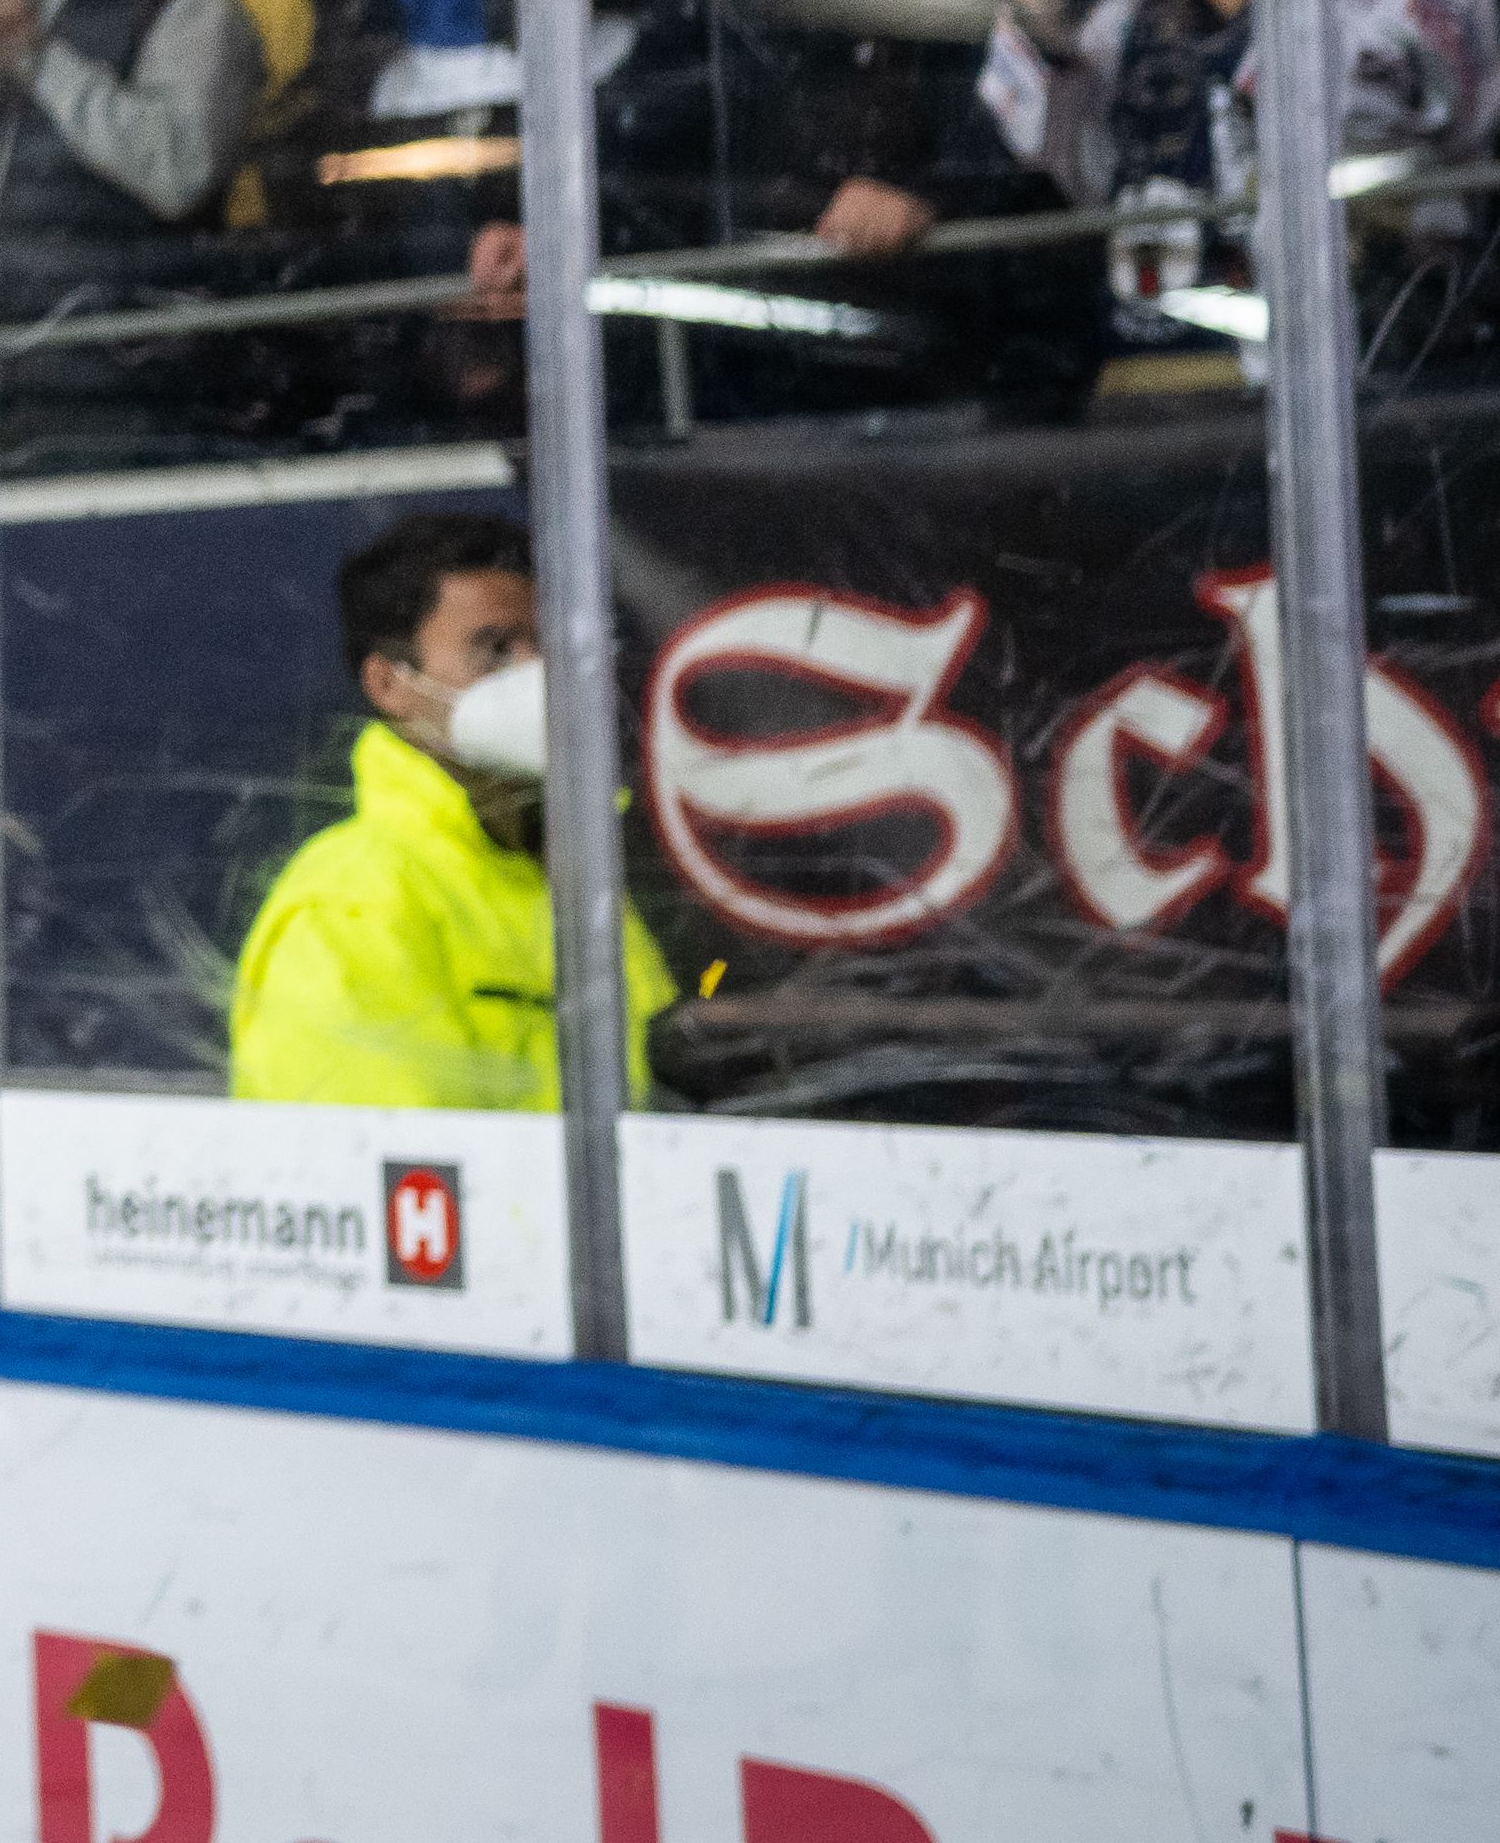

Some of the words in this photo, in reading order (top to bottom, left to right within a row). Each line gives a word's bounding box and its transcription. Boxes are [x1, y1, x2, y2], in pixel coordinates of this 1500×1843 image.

[646, 564, 1500, 996] Sch
[86, 1172, 366, 1255] heinemann
[1034, 1226, 1198, 1312] Airport
